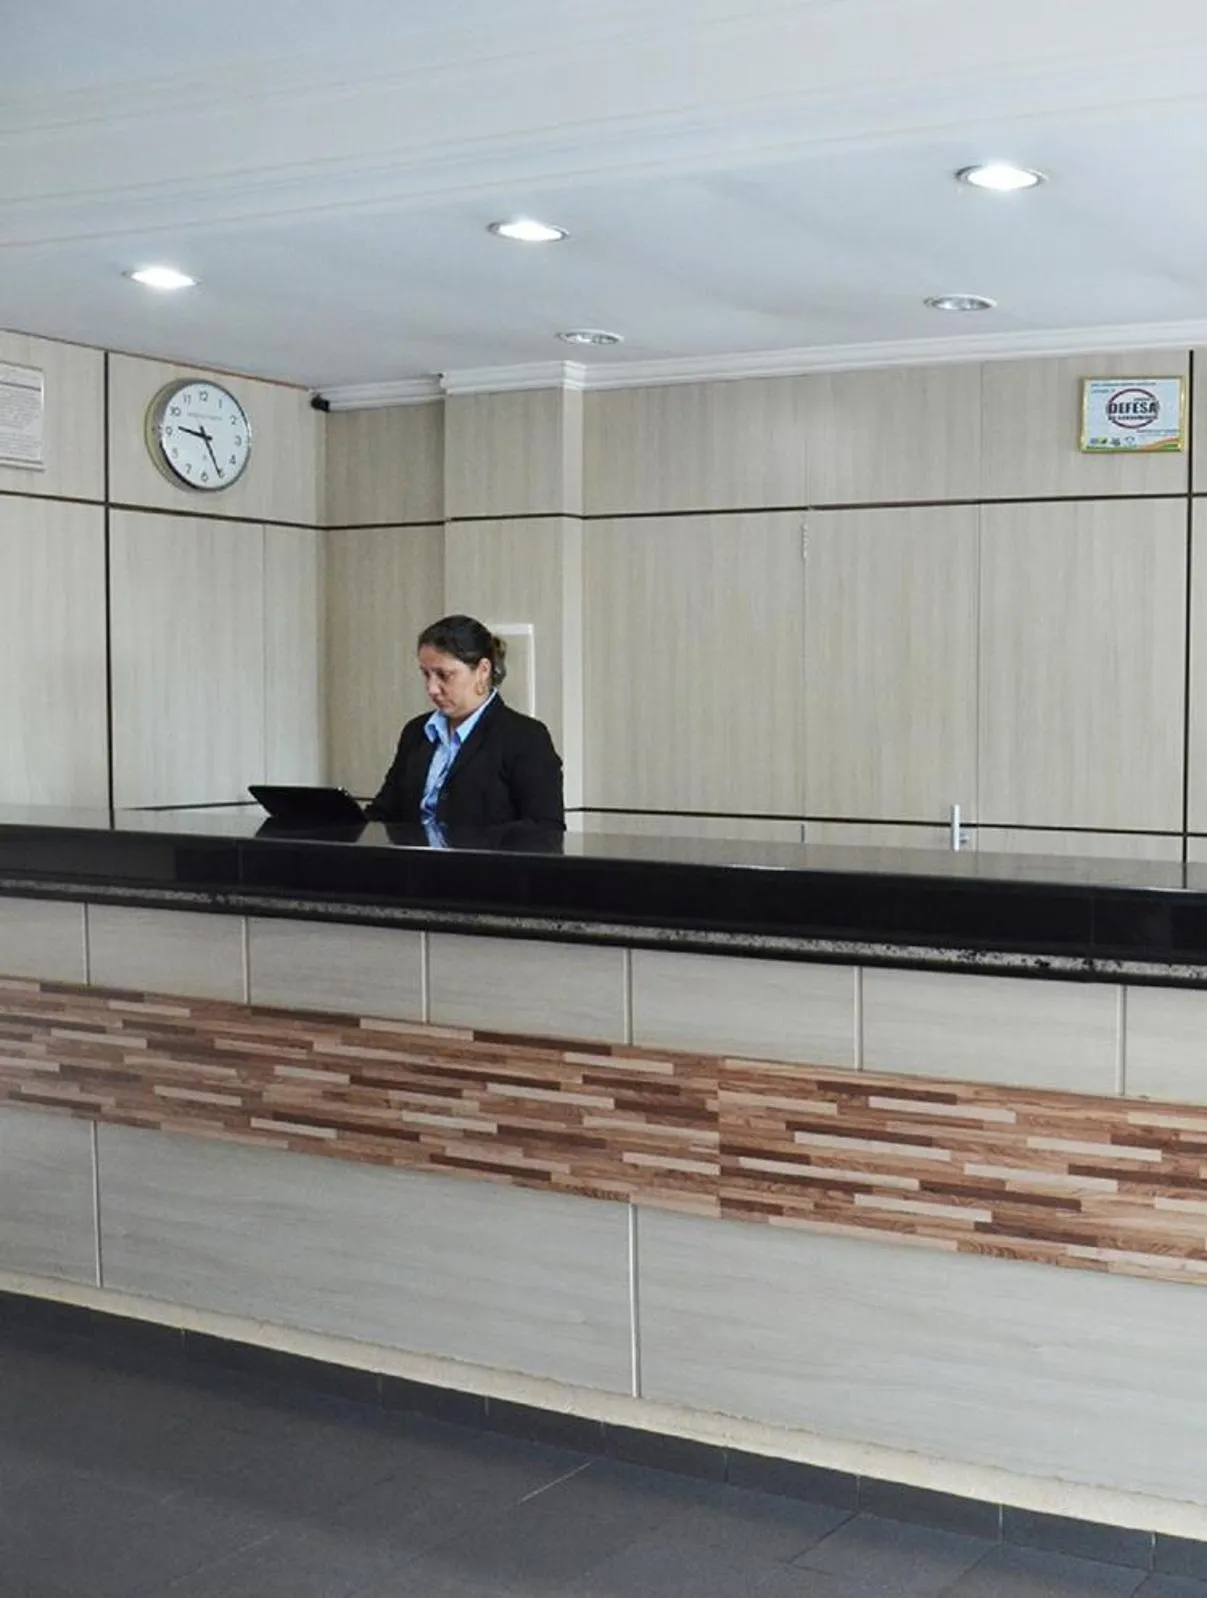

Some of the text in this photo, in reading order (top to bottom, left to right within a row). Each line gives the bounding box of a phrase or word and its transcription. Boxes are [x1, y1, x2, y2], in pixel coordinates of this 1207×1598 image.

[183, 394, 191, 405] 11
[199, 390, 209, 402] 12
[170, 406, 181, 417] 10
[1107, 401, 1158, 414] DEFESA
[230, 414, 237, 426] 2
[166, 425, 173, 436] 9
[234, 435, 242, 447] 3
[229, 453, 237, 465] 4
[184, 463, 192, 475] 7
[200, 471, 208, 483] 6
